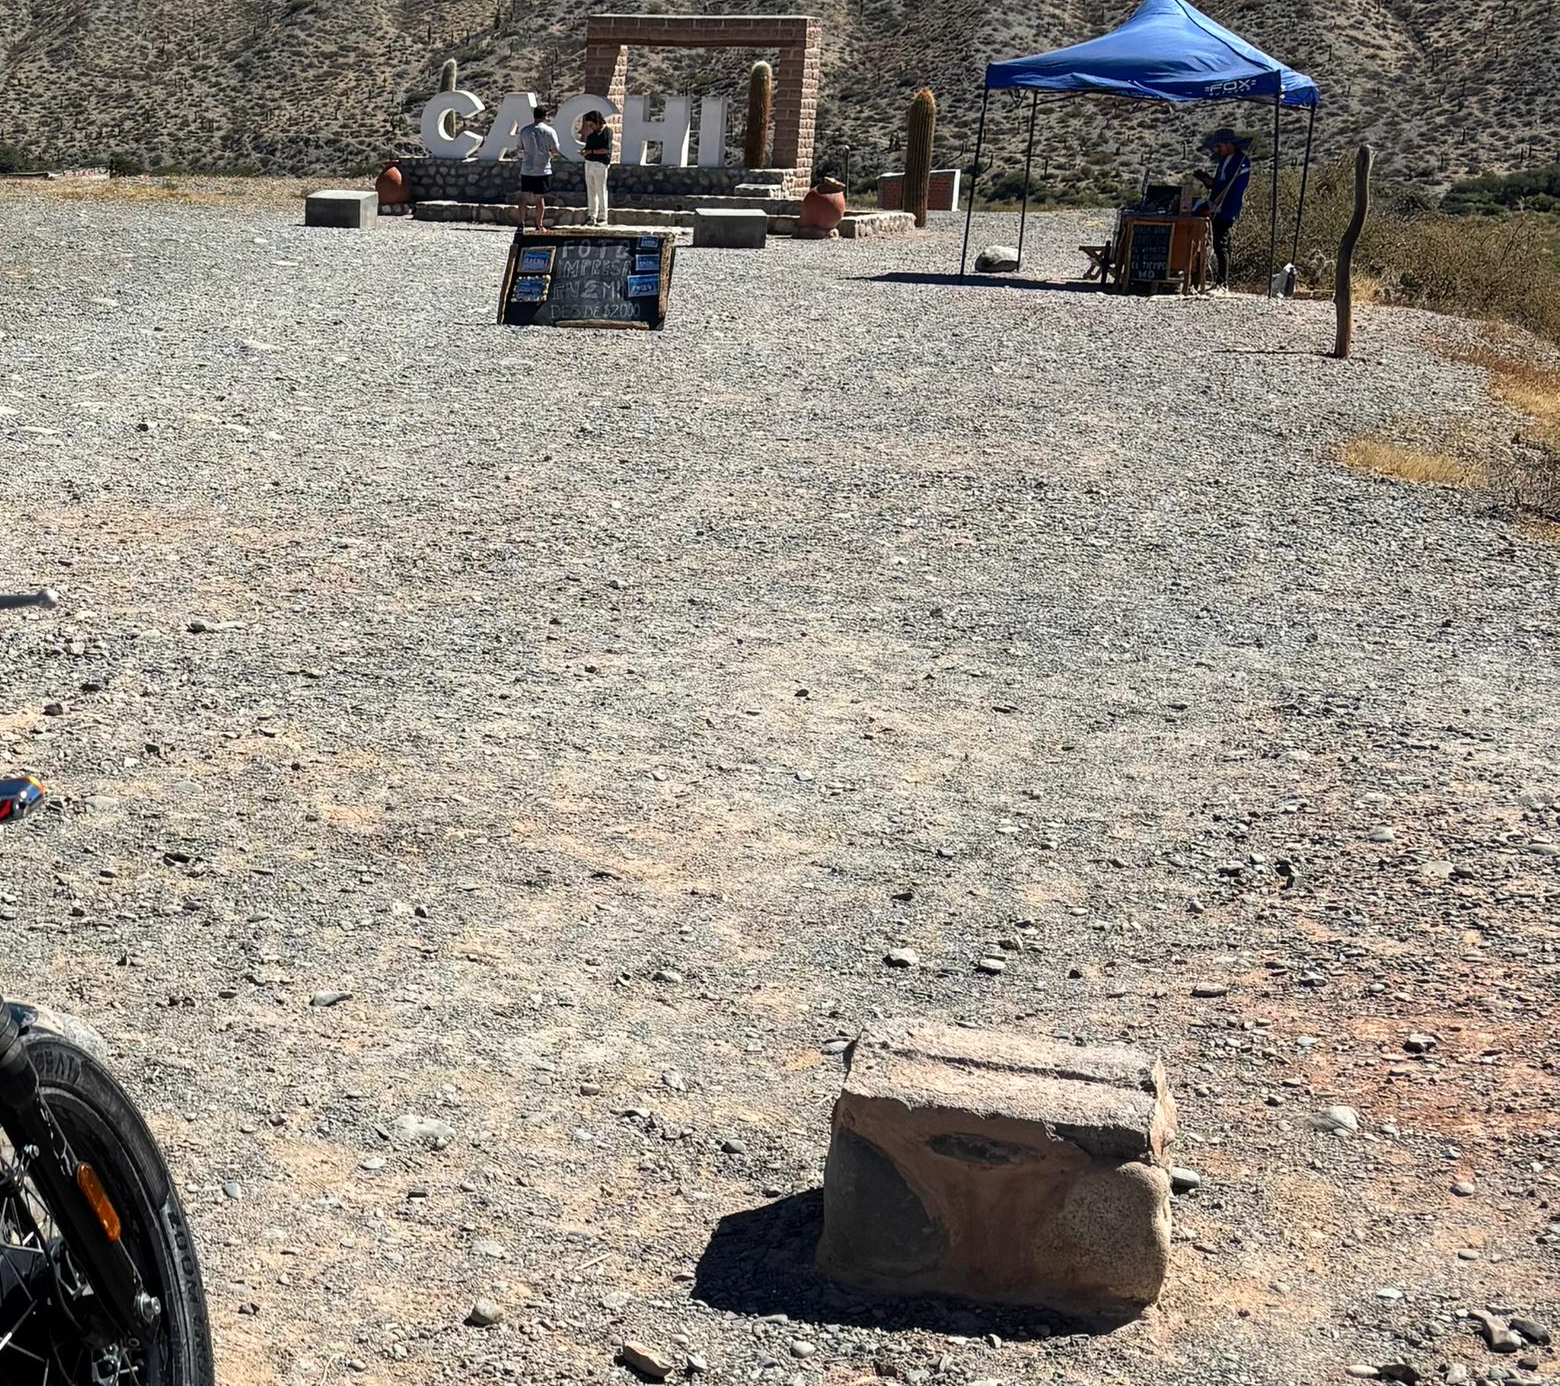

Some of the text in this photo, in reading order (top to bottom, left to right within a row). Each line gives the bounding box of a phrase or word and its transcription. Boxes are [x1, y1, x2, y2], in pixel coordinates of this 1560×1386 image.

[1209, 79, 1251, 92] FOX
[420, 89, 729, 168] CACHI
[556, 259, 632, 278] IMPRESA
[551, 304, 600, 319] DESDE
